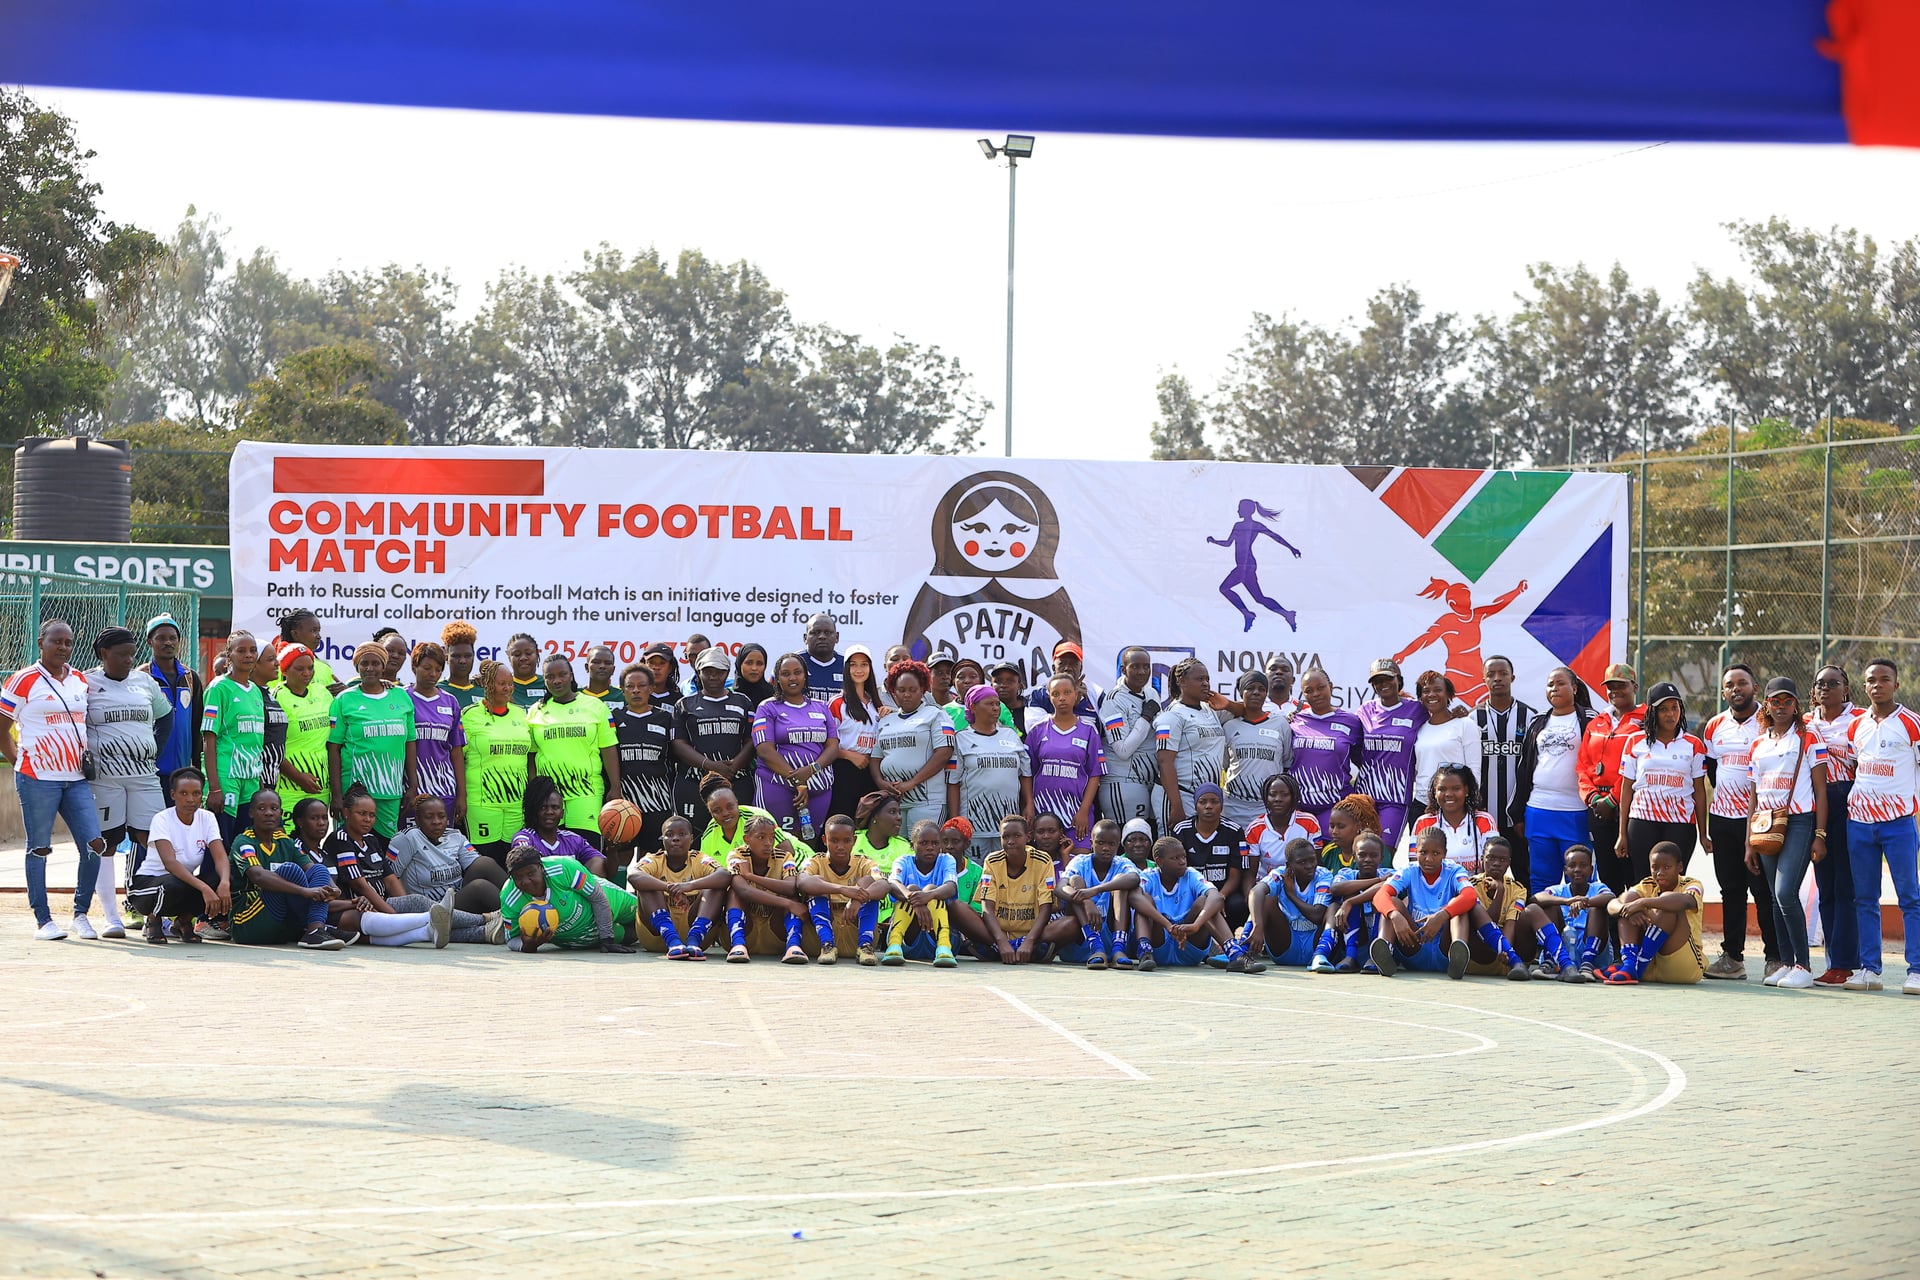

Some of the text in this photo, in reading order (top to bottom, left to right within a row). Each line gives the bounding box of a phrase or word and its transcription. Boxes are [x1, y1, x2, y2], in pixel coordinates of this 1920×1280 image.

[269, 500, 853, 541] COMMUNITY FOOTBALL
[269, 538, 446, 573] MATCH
[73, 556, 214, 589] SPORTS
[267, 582, 899, 607] Path to Russia Community Football Match is an initiative designed to foster
[266, 603, 863, 627] cro cultural collaboration through the universal language of foball.
[953, 608, 1034, 646] PATH
[981, 644, 1005, 660] TO
[103, 711, 121, 723] PATH
[121, 710, 131, 721] TO
[363, 725, 378, 738] PATH
[379, 724, 387, 737] TO
[544, 726, 587, 740] PATH TO RUSSIA
[698, 723, 712, 736] PATH
[713, 722, 721, 734] TO
[788, 731, 803, 744] PATH
[803, 731, 811, 743] TO
[897, 735, 917, 748] RUSSIA
[1305, 738, 1314, 750] TO
[1314, 738, 1335, 751] RUSSIA
[490, 745, 504, 756] PATH
[504, 744, 512, 755] TO
[1375, 739, 1383, 751] TO
[1494, 741, 1521, 756] sela
[621, 749, 635, 762] PATH
[635, 749, 643, 761] TO
[1248, 748, 1256, 759] TO
[1256, 748, 1275, 762] RUSSIA
[977, 757, 991, 769] PATH
[991, 757, 999, 769] TO
[1053, 764, 1060, 776] TO
[1872, 762, 1895, 777] RUSSIA
[684, 803, 695, 818] 4
[1136, 804, 1146, 817] 2
[406, 817, 417, 829] 5
[479, 823, 490, 837] 5
[782, 816, 794, 830] 2
[971, 845, 981, 859] 4
